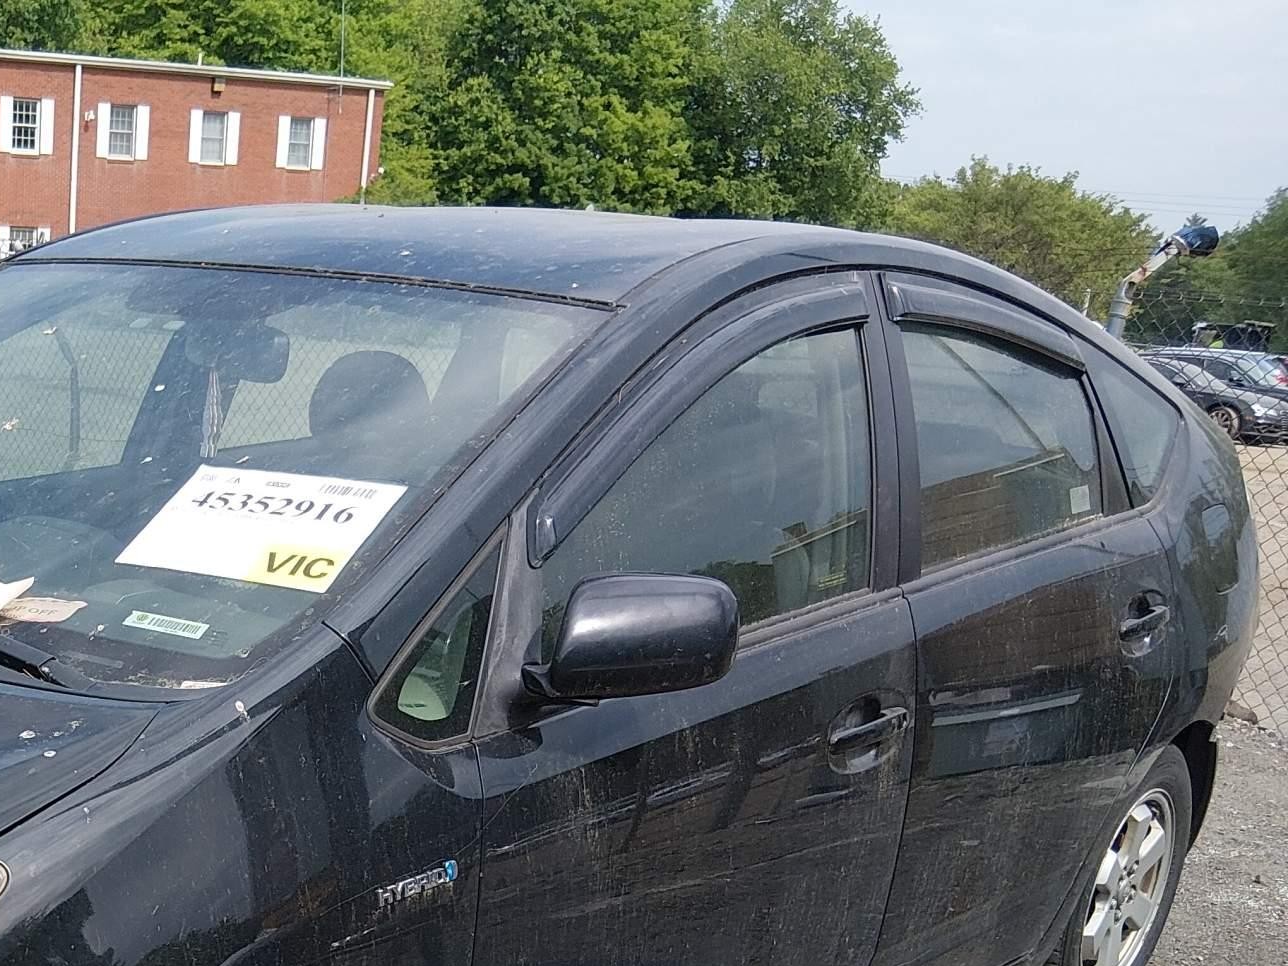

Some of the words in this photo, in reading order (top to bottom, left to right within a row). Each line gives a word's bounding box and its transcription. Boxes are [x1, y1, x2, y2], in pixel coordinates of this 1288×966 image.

[191, 490, 360, 525] 45352916
[265, 551, 335, 579] VIC
[27, 607, 59, 616] OFF
[375, 866, 448, 908] HYBRID
